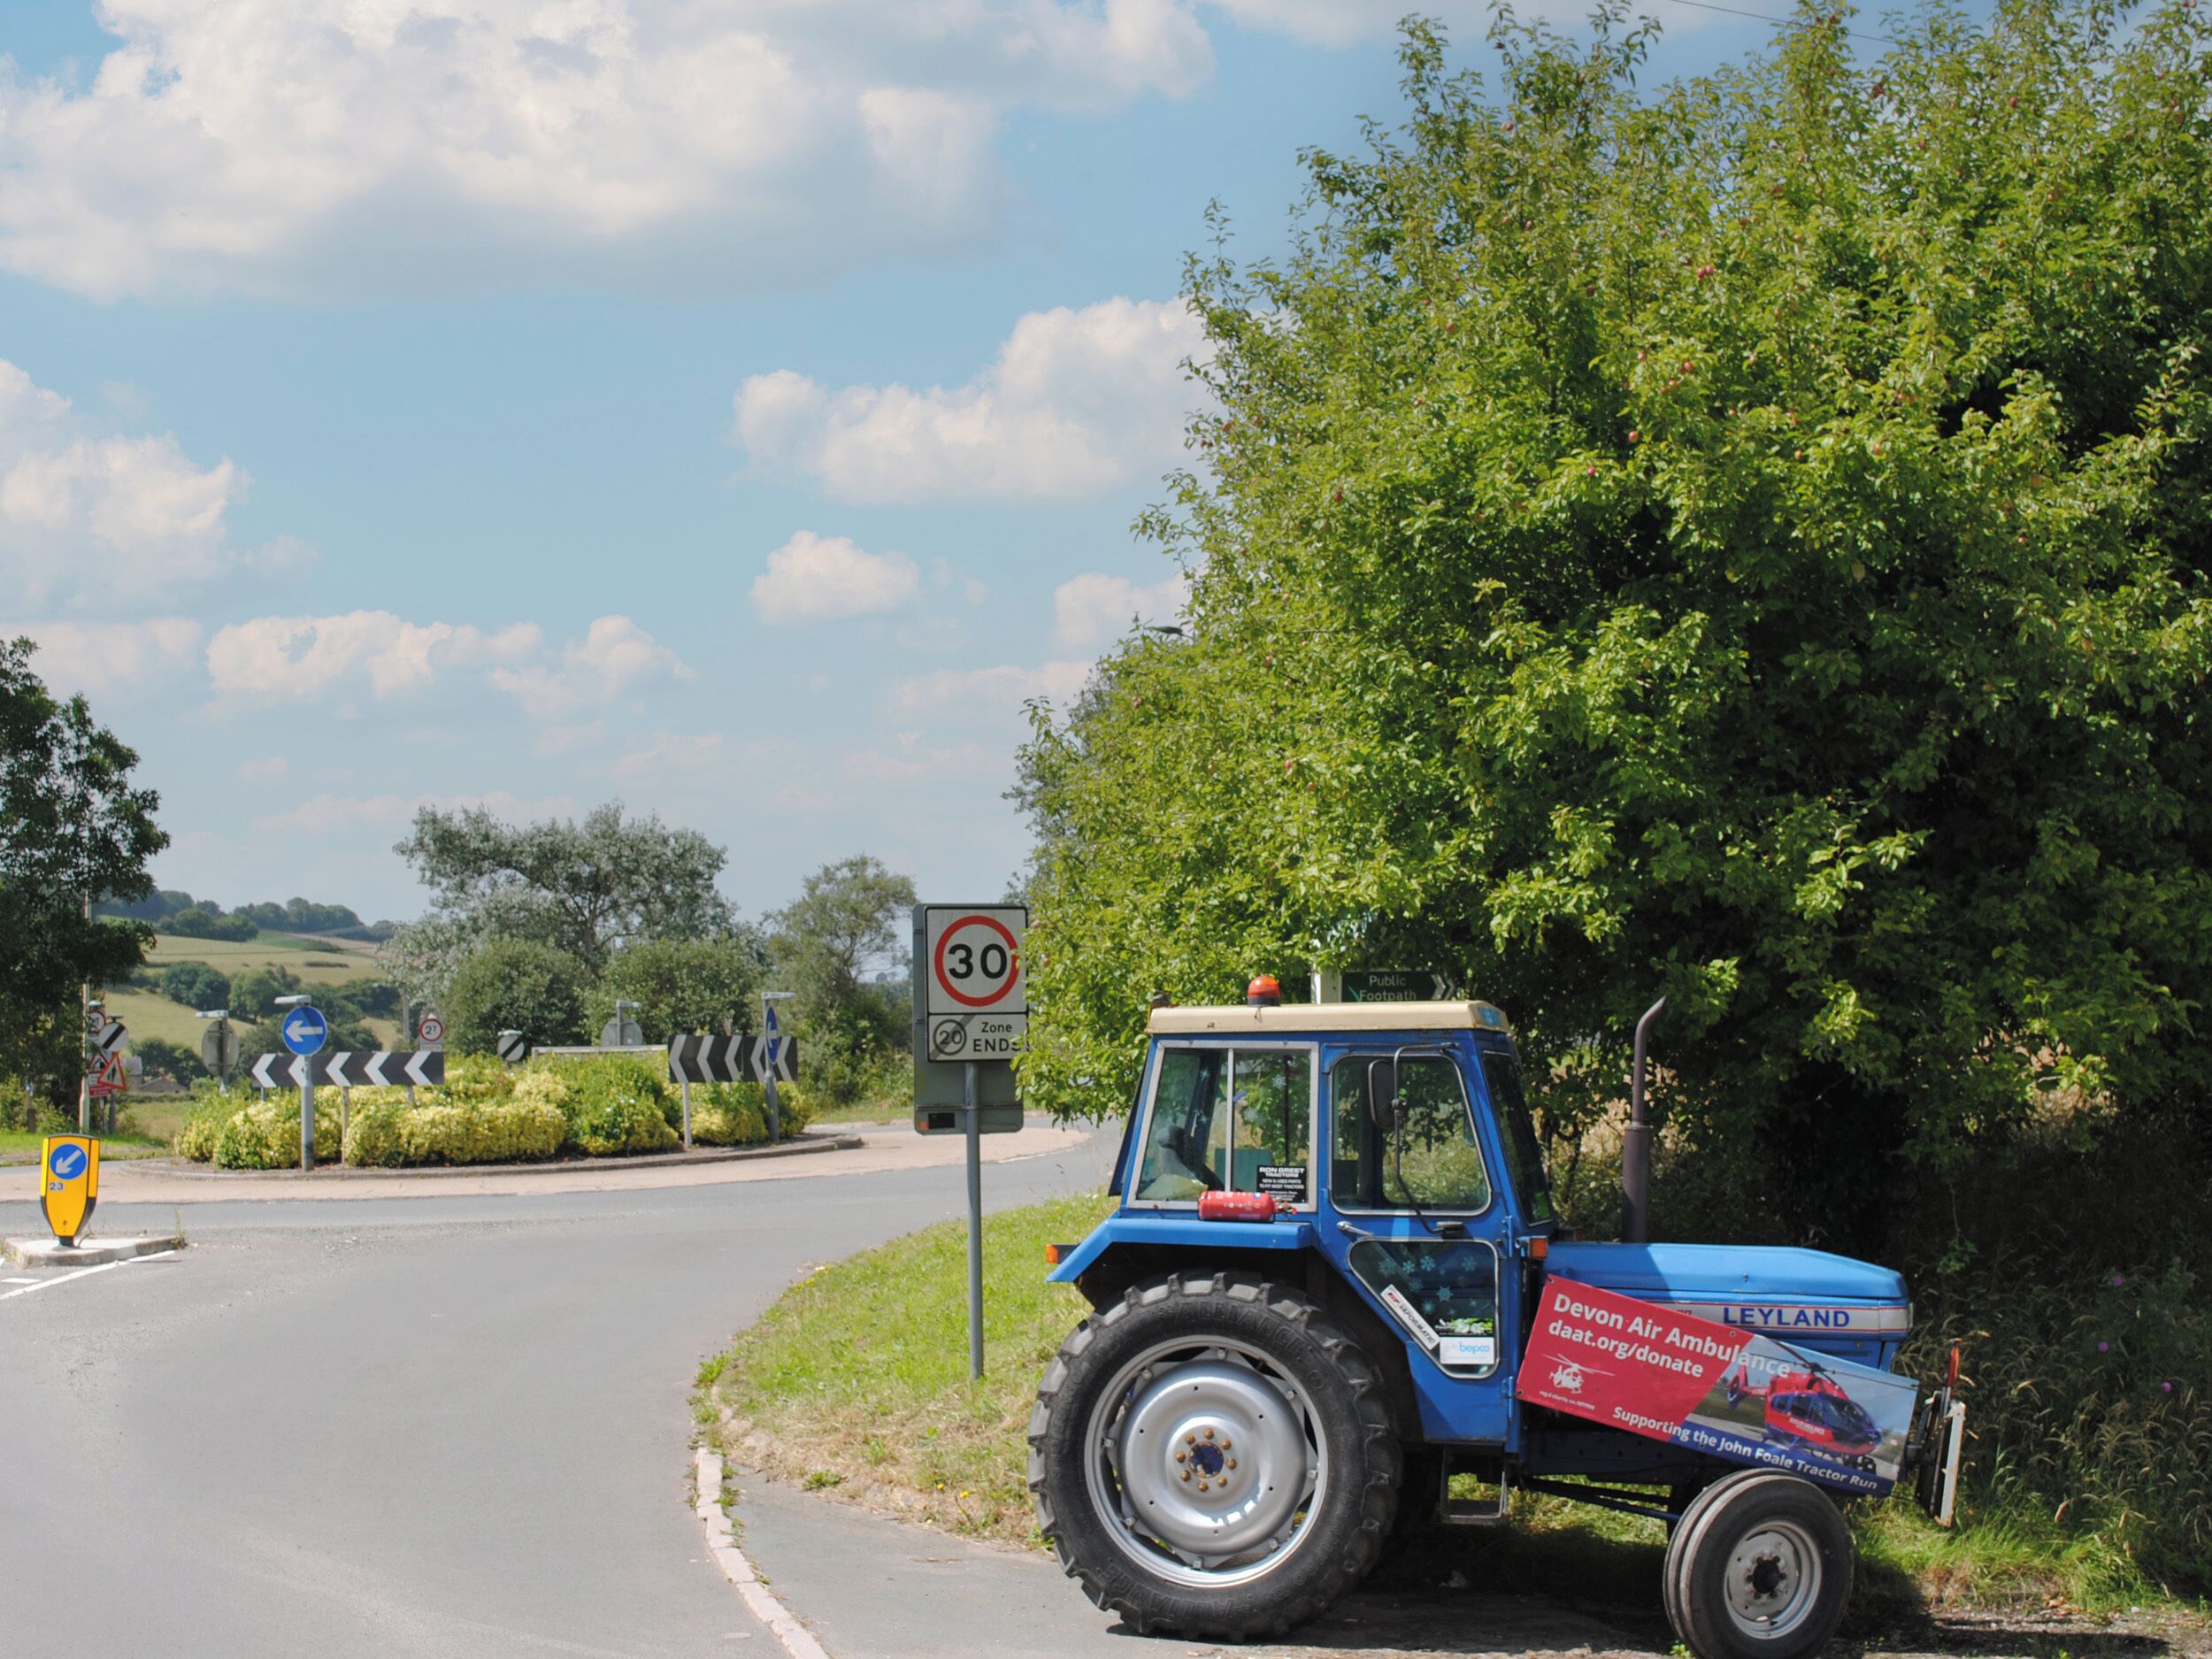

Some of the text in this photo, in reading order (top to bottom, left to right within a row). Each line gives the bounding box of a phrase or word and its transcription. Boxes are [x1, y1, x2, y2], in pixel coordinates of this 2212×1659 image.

[948, 943, 1007, 979] 30
[1369, 974, 1406, 987] Public
[1359, 989, 1417, 1002] Footpath
[425, 1025, 437, 1034] 2T
[981, 1021, 1012, 1033] Zone
[940, 1030, 963, 1044] 20
[50, 1182, 64, 1191] 23
[1399, 1302, 1435, 1344] VAPORMATIC
[1723, 1307, 1850, 1327] LEYLAND
[1553, 1293, 1791, 1379] Devon Air Ambulance
[1458, 1341, 1490, 1355] bepco
[1548, 1319, 1704, 1379] daat.org/donate
[1613, 1406, 1878, 1490] Supporting the John Foale Tractor Run
